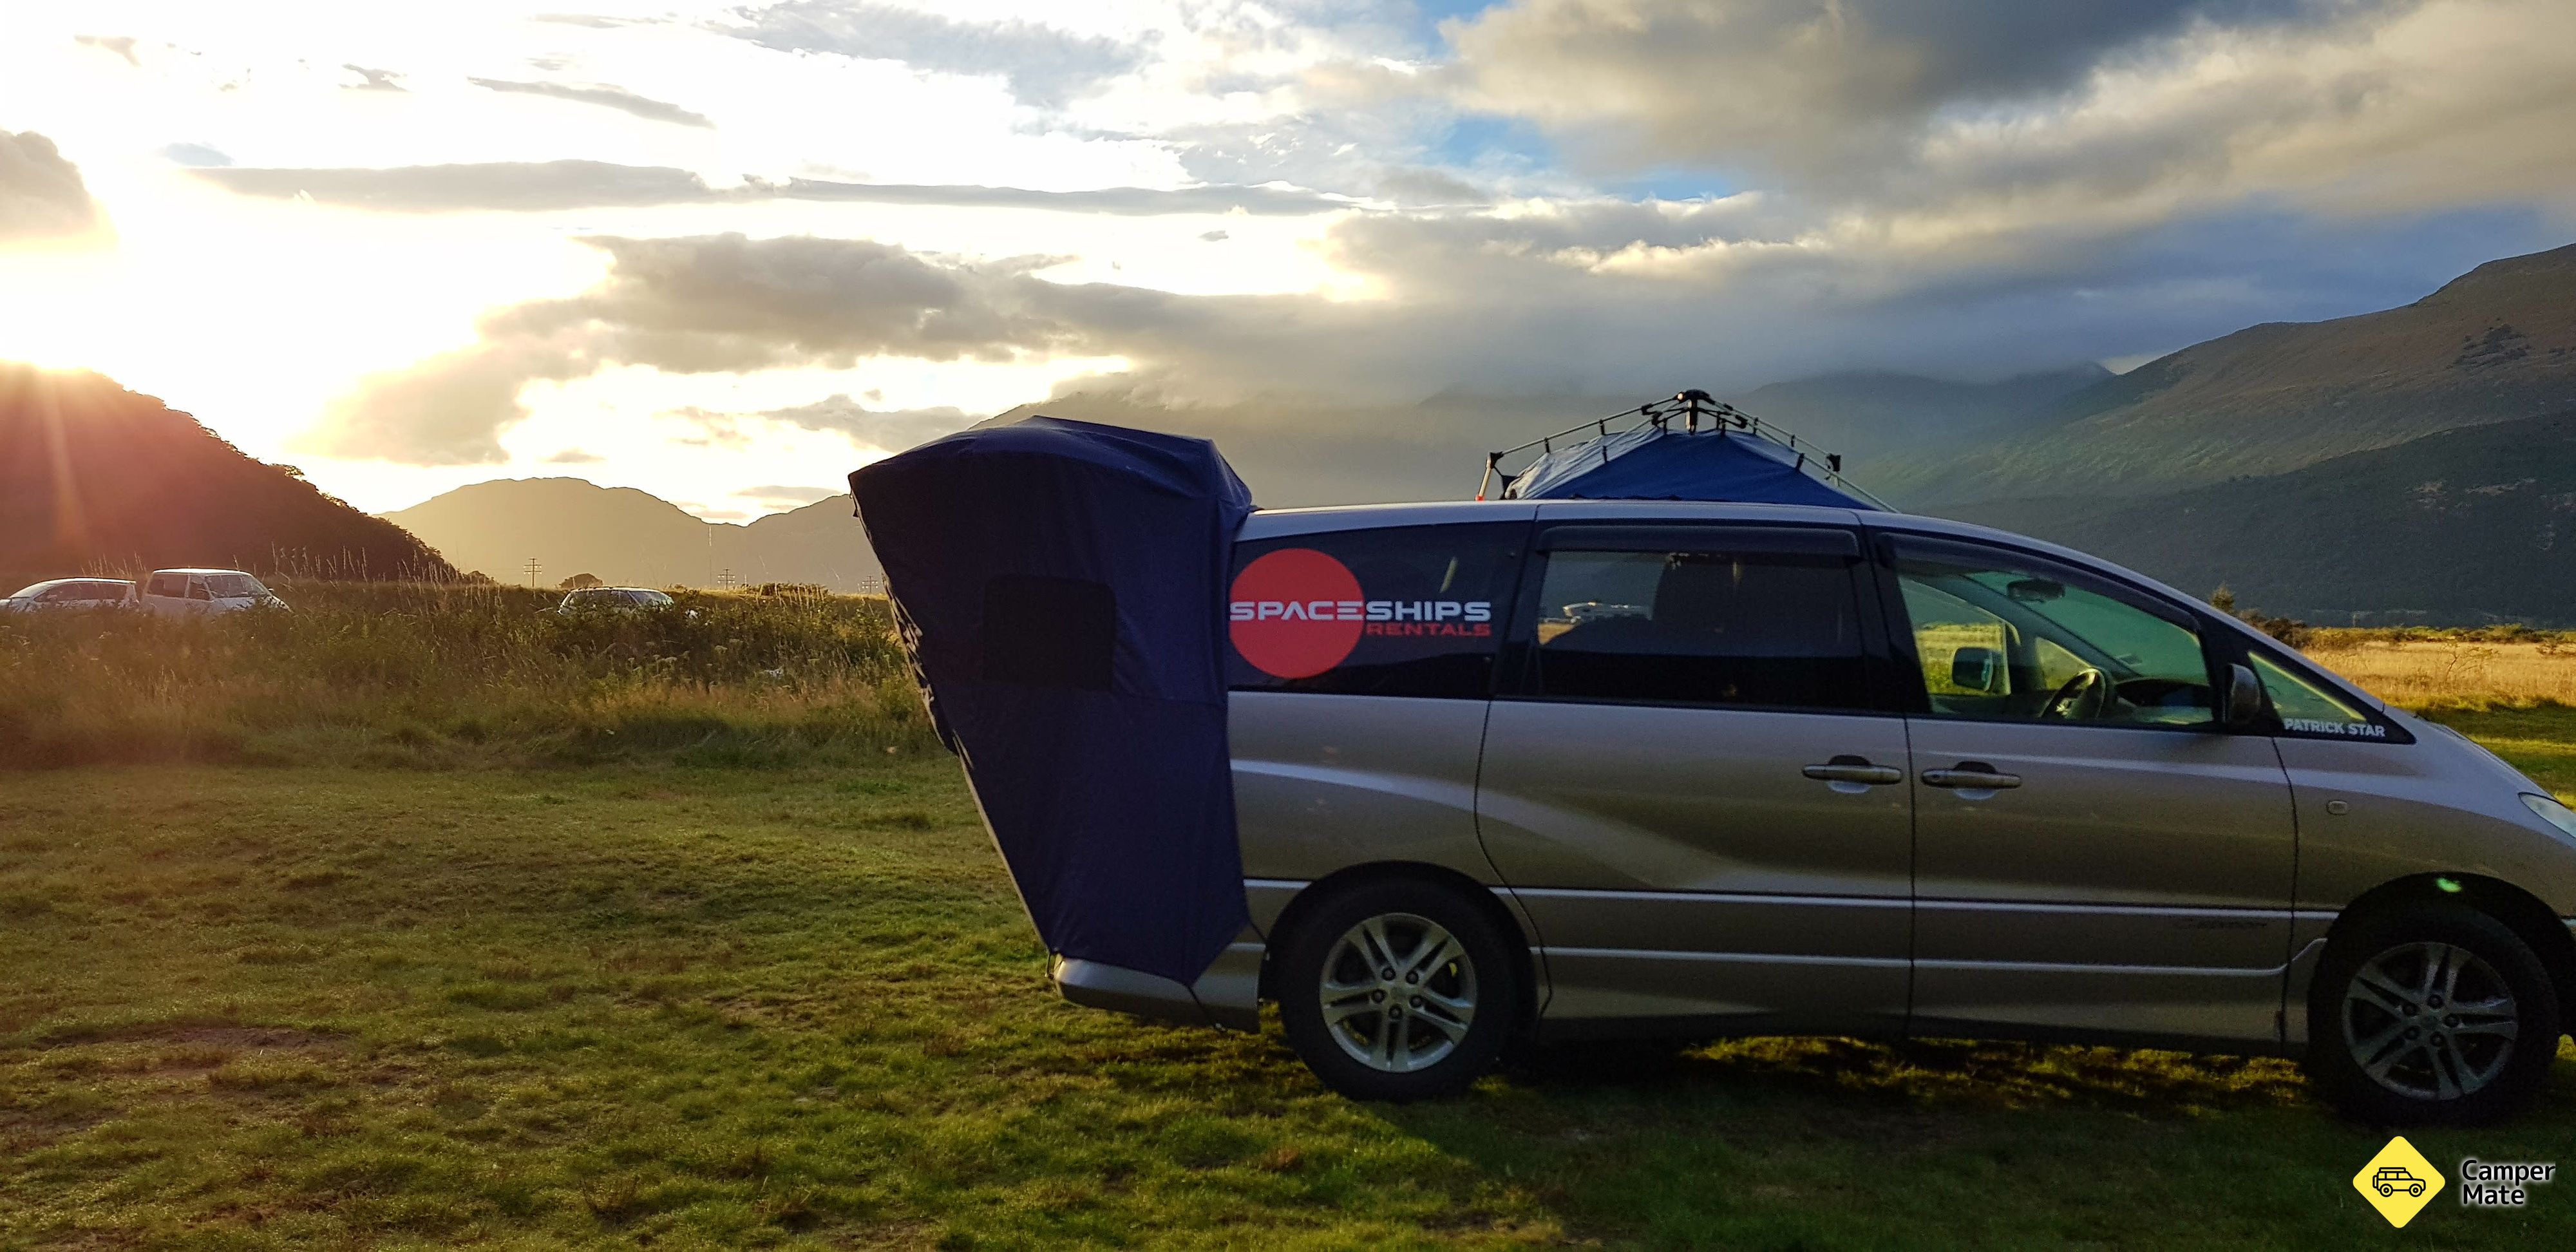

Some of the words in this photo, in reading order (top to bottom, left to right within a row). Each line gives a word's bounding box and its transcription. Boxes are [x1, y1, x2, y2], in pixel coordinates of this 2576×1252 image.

[1229, 601, 1492, 621] SPACESHIPS
[1367, 623, 1491, 636] RENTALS
[2284, 718, 2344, 734] PATRICK
[2348, 724, 2385, 737] STAR
